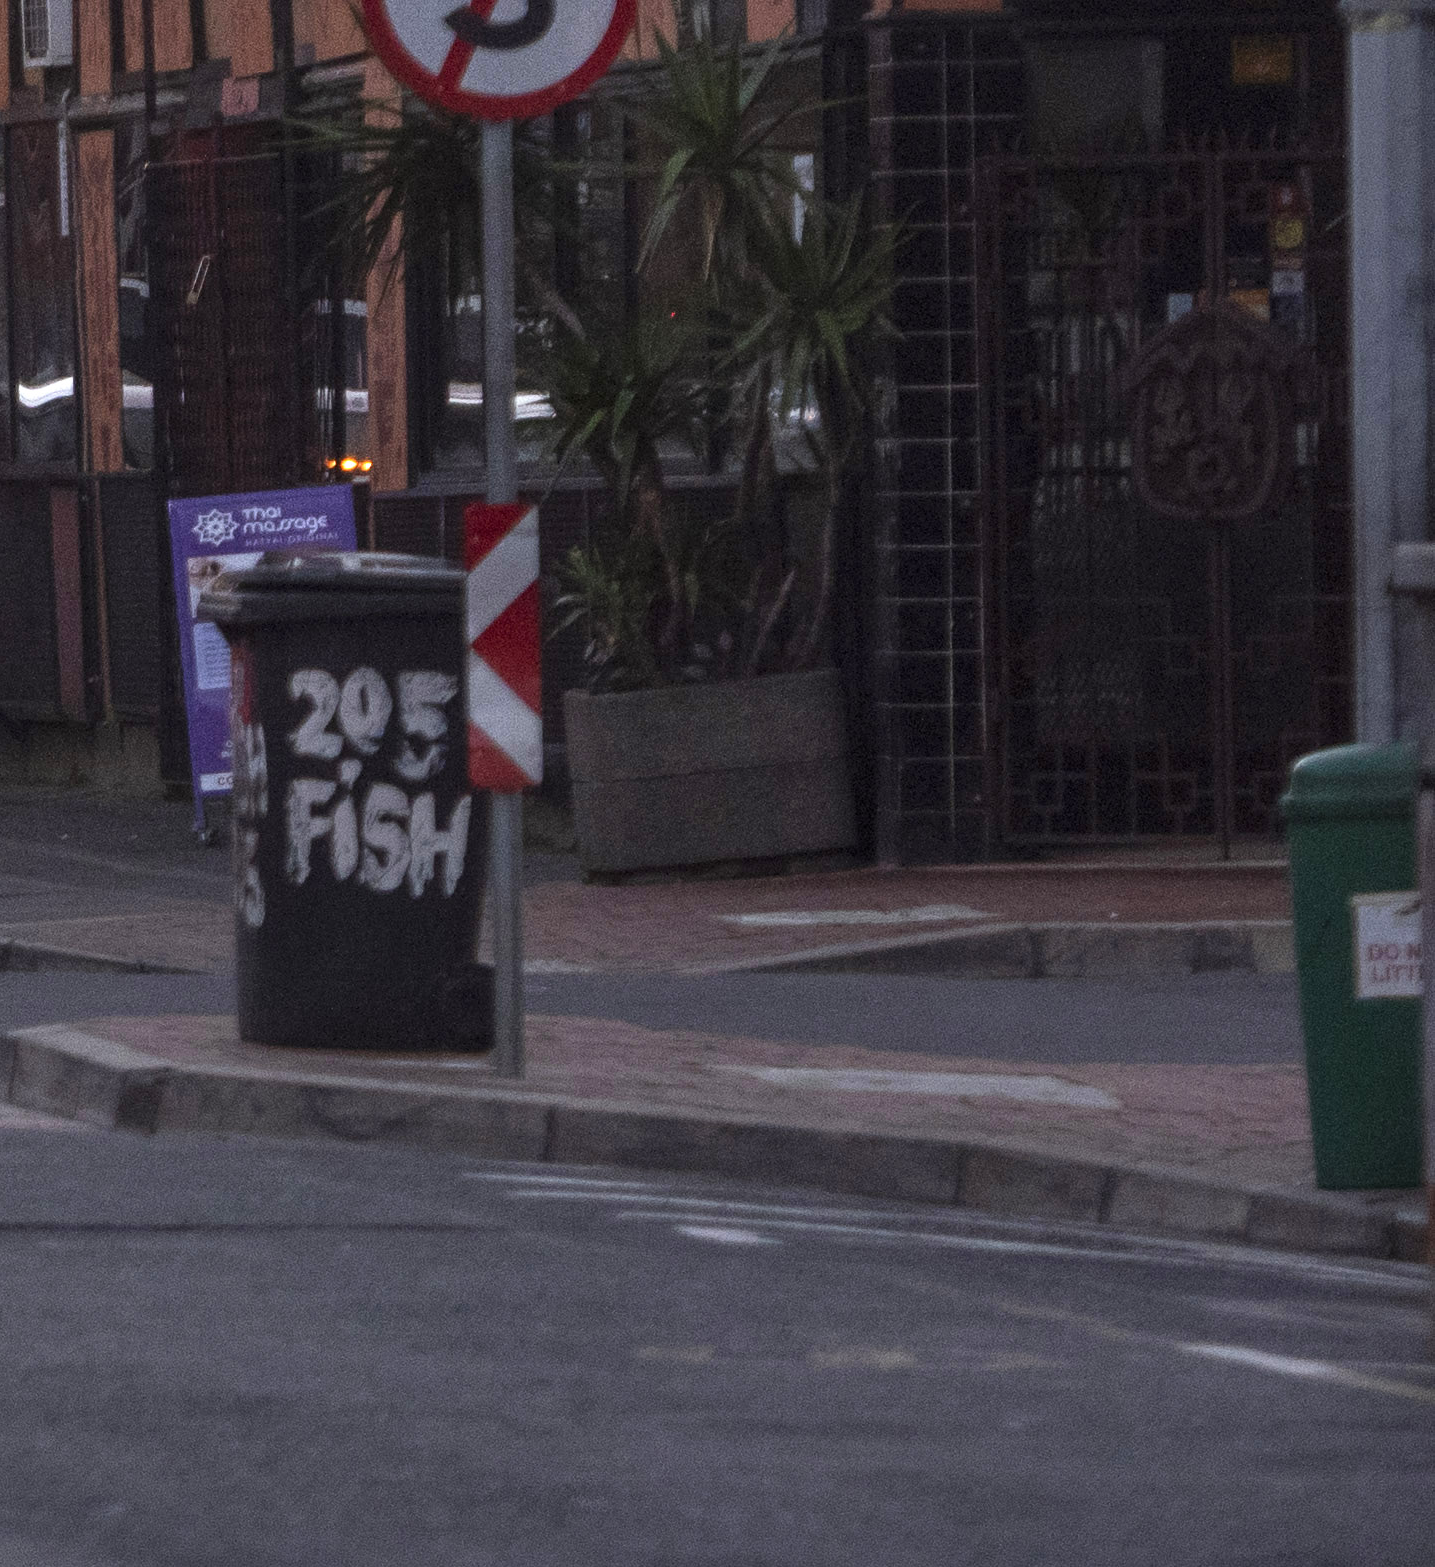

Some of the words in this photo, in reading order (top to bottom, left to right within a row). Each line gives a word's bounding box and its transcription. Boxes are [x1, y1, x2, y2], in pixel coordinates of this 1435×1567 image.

[242, 505, 282, 521] Thai
[243, 514, 328, 537] massage
[288, 665, 459, 781] 205
